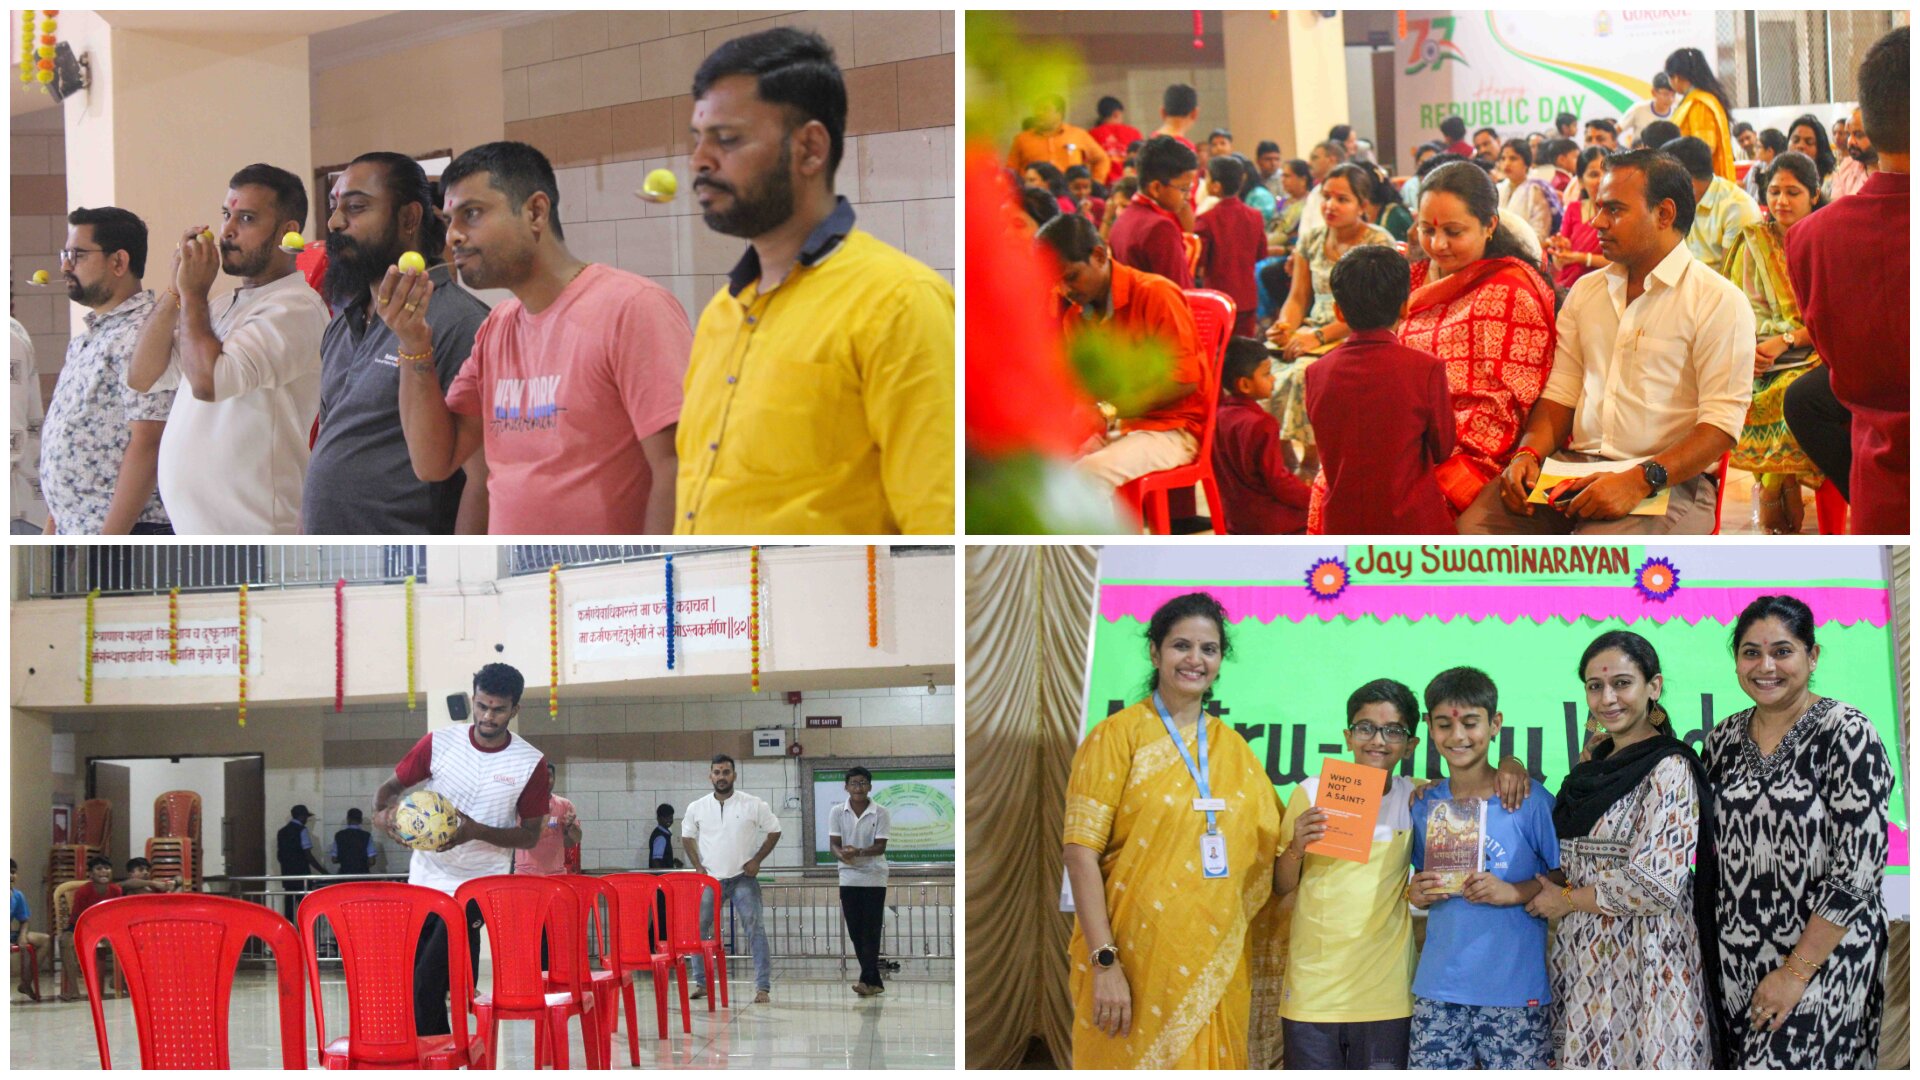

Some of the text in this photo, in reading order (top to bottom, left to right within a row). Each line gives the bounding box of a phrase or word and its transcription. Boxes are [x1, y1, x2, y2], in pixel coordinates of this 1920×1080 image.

[1420, 95, 1586, 129] REPUBLIC DAY
[494, 375, 561, 420] NEW YORK
[1355, 545, 1412, 579] Jay
[1327, 782, 1347, 792] NOT
[1330, 773, 1352, 784] WHO
[1334, 793, 1366, 805] SAINT?
